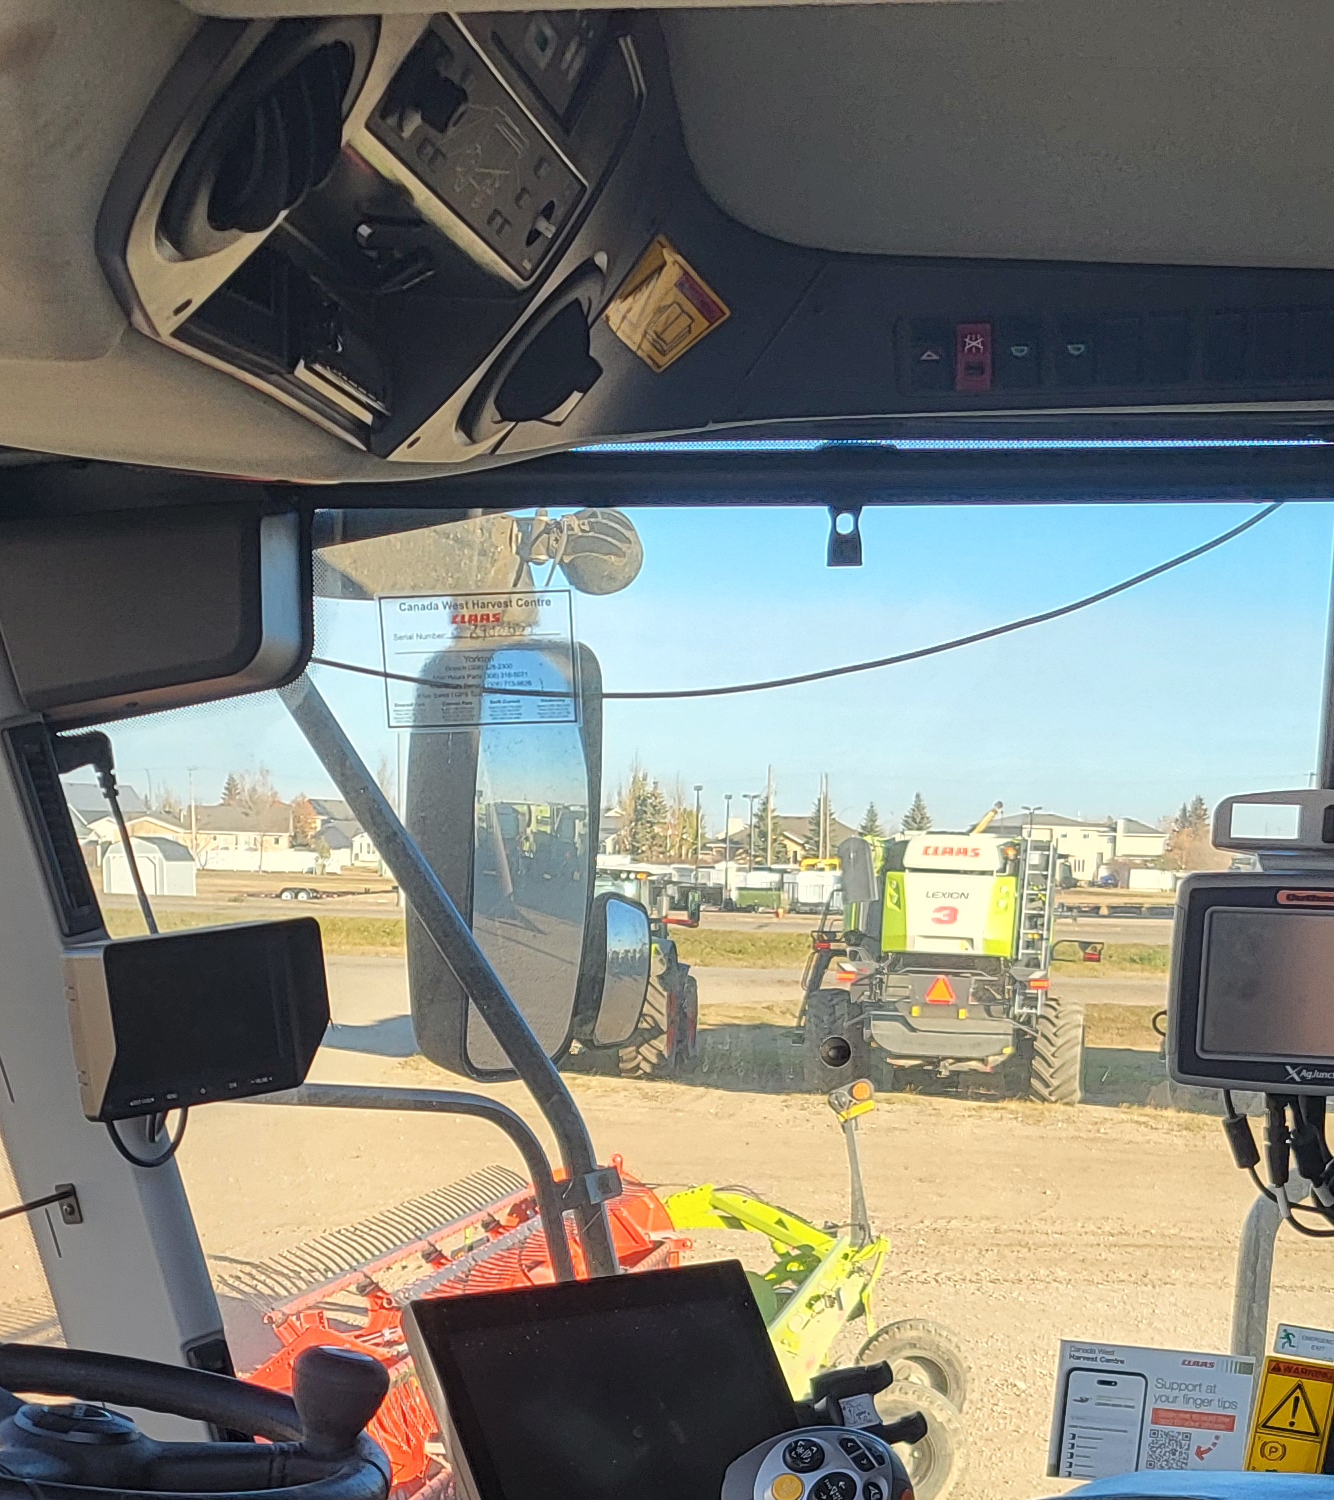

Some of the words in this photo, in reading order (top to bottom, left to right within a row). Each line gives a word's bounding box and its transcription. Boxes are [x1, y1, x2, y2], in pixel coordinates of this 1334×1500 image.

[399, 602, 439, 612] Canada
[442, 601, 469, 611] West
[472, 599, 512, 610] Harvest
[516, 597, 552, 608] Centre
[451, 612, 501, 625] CLAAS
[393, 632, 414, 642] Serial
[416, 632, 446, 641] Number
[922, 845, 981, 858] CLAAS
[925, 891, 970, 900] LEXION
[931, 906, 959, 925] 3
[1069, 1345, 1097, 1355] Canada
[1097, 1347, 1116, 1357] West
[1069, 1353, 1099, 1364] Harvest
[1099, 1356, 1125, 1366] Centre
[1180, 1358, 1216, 1369] CLAAS
[1283, 1364, 1334, 1381] WARNING
[1154, 1377, 1203, 1393] Support
[1205, 1382, 1217, 1394] at
[1152, 1393, 1178, 1406] your
[1182, 1394, 1214, 1409] finger
[1217, 1398, 1239, 1410] tips
